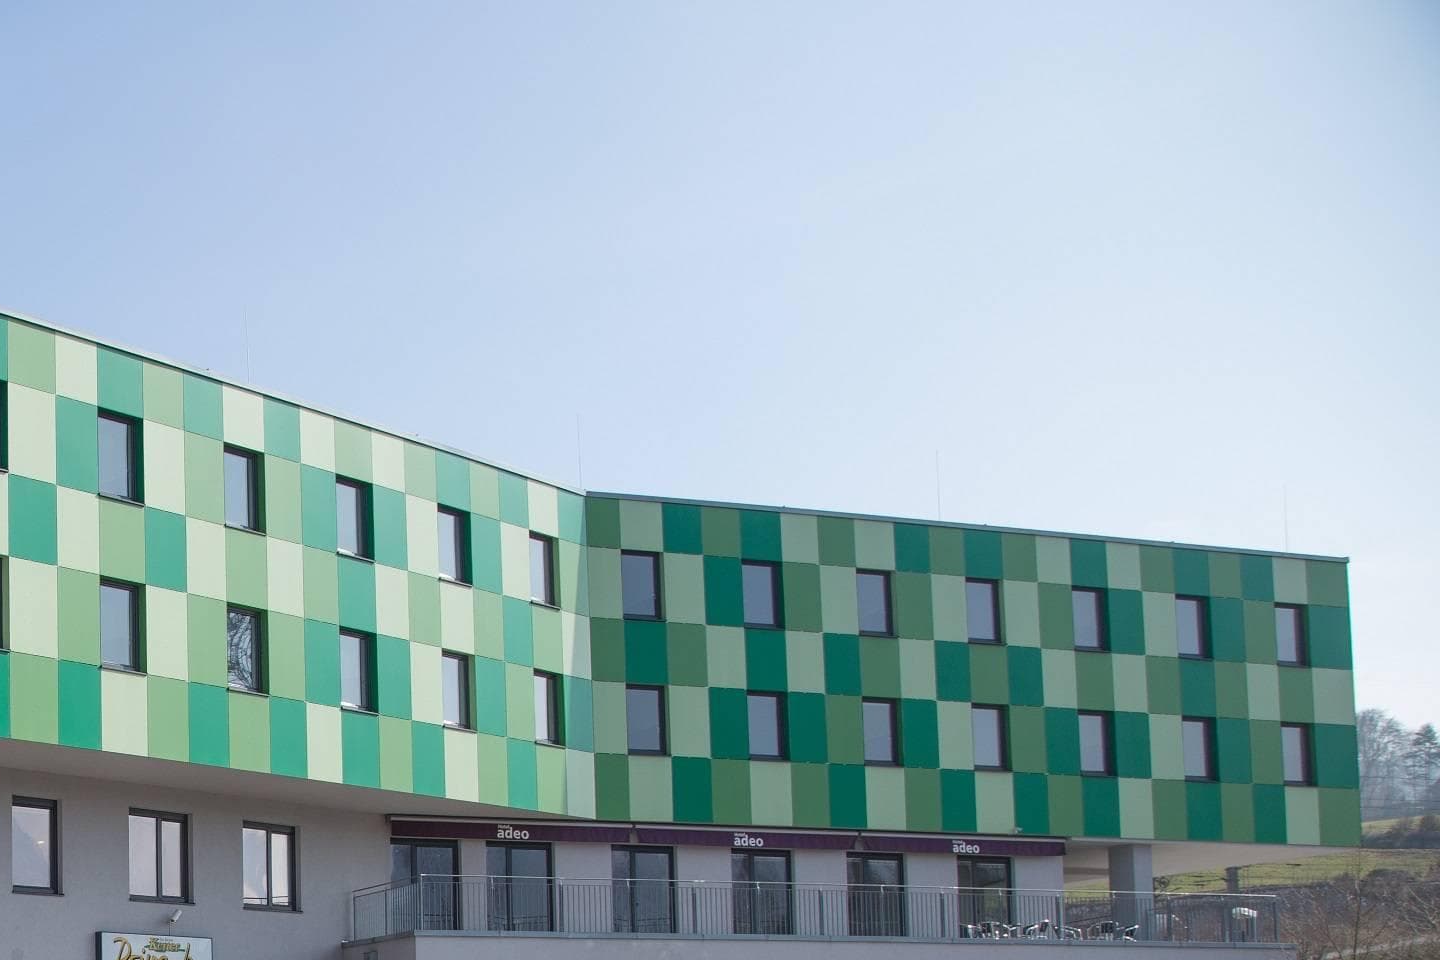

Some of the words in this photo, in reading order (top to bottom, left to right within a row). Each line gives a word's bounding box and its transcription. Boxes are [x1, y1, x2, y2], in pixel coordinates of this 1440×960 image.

[497, 826, 529, 839] adeo
[734, 834, 764, 847] adeo
[952, 842, 980, 853] adeo
